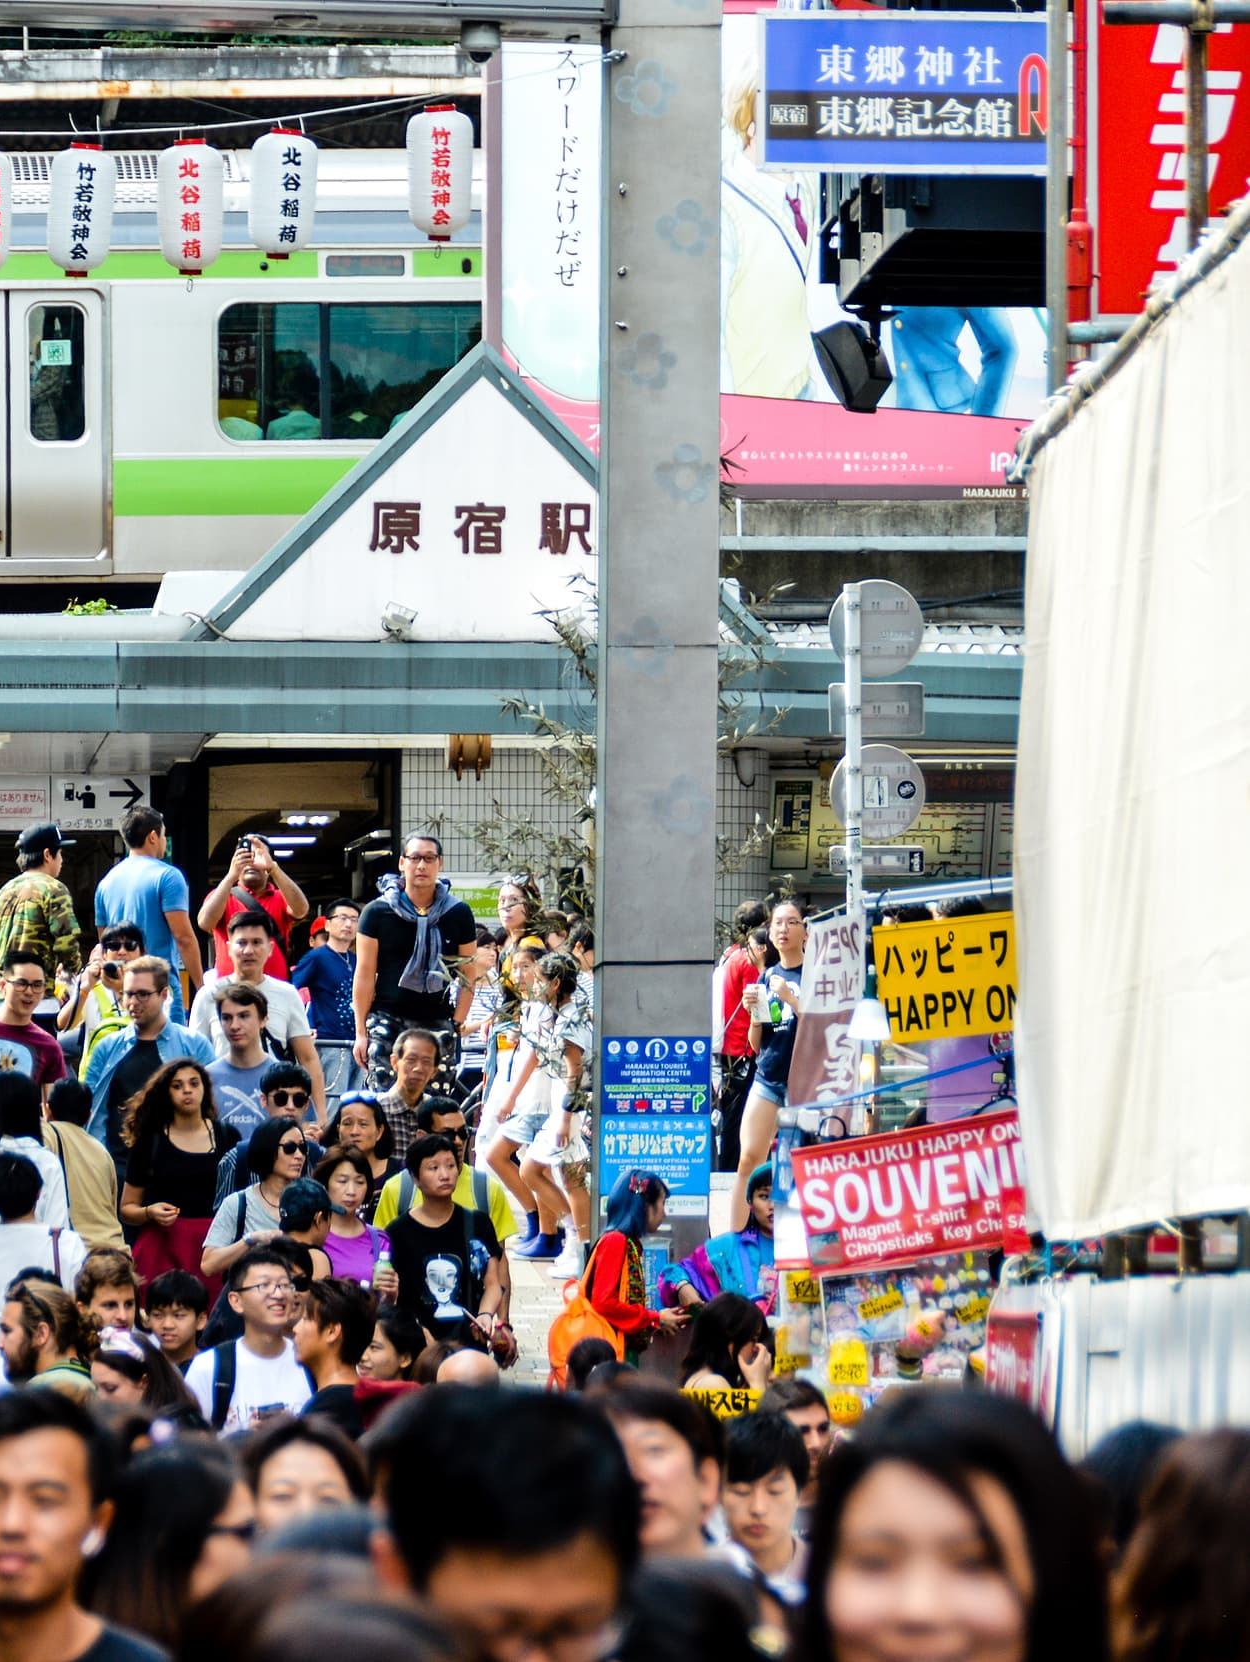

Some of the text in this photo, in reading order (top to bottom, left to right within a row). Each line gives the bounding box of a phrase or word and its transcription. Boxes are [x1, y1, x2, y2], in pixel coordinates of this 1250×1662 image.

[816, 44, 1003, 85] 東郷神社
[771, 106, 807, 125] 原宿
[816, 96, 1013, 138] 東郷記念館
[278, 146, 302, 244] 北谷稲荷
[431, 126, 452, 226] 竹若敬神会
[70, 162, 97, 260] 竹若敬神会
[178, 157, 202, 260] 北谷稲荷
[963, 487, 1016, 498] HARAJUKU
[369, 501, 592, 555] 原宿駅
[884, 988, 975, 1032] HAPPY
[604, 1132, 708, 1155] 竹下通り公式マップ
[804, 1143, 913, 1177] HARAJUKU
[918, 1128, 985, 1158] HAPPY
[841, 1219, 902, 1242] Magnet
[913, 1206, 967, 1228] T-shirt
[844, 1231, 934, 1259] Chopsticks
[943, 1223, 973, 1244] Key
